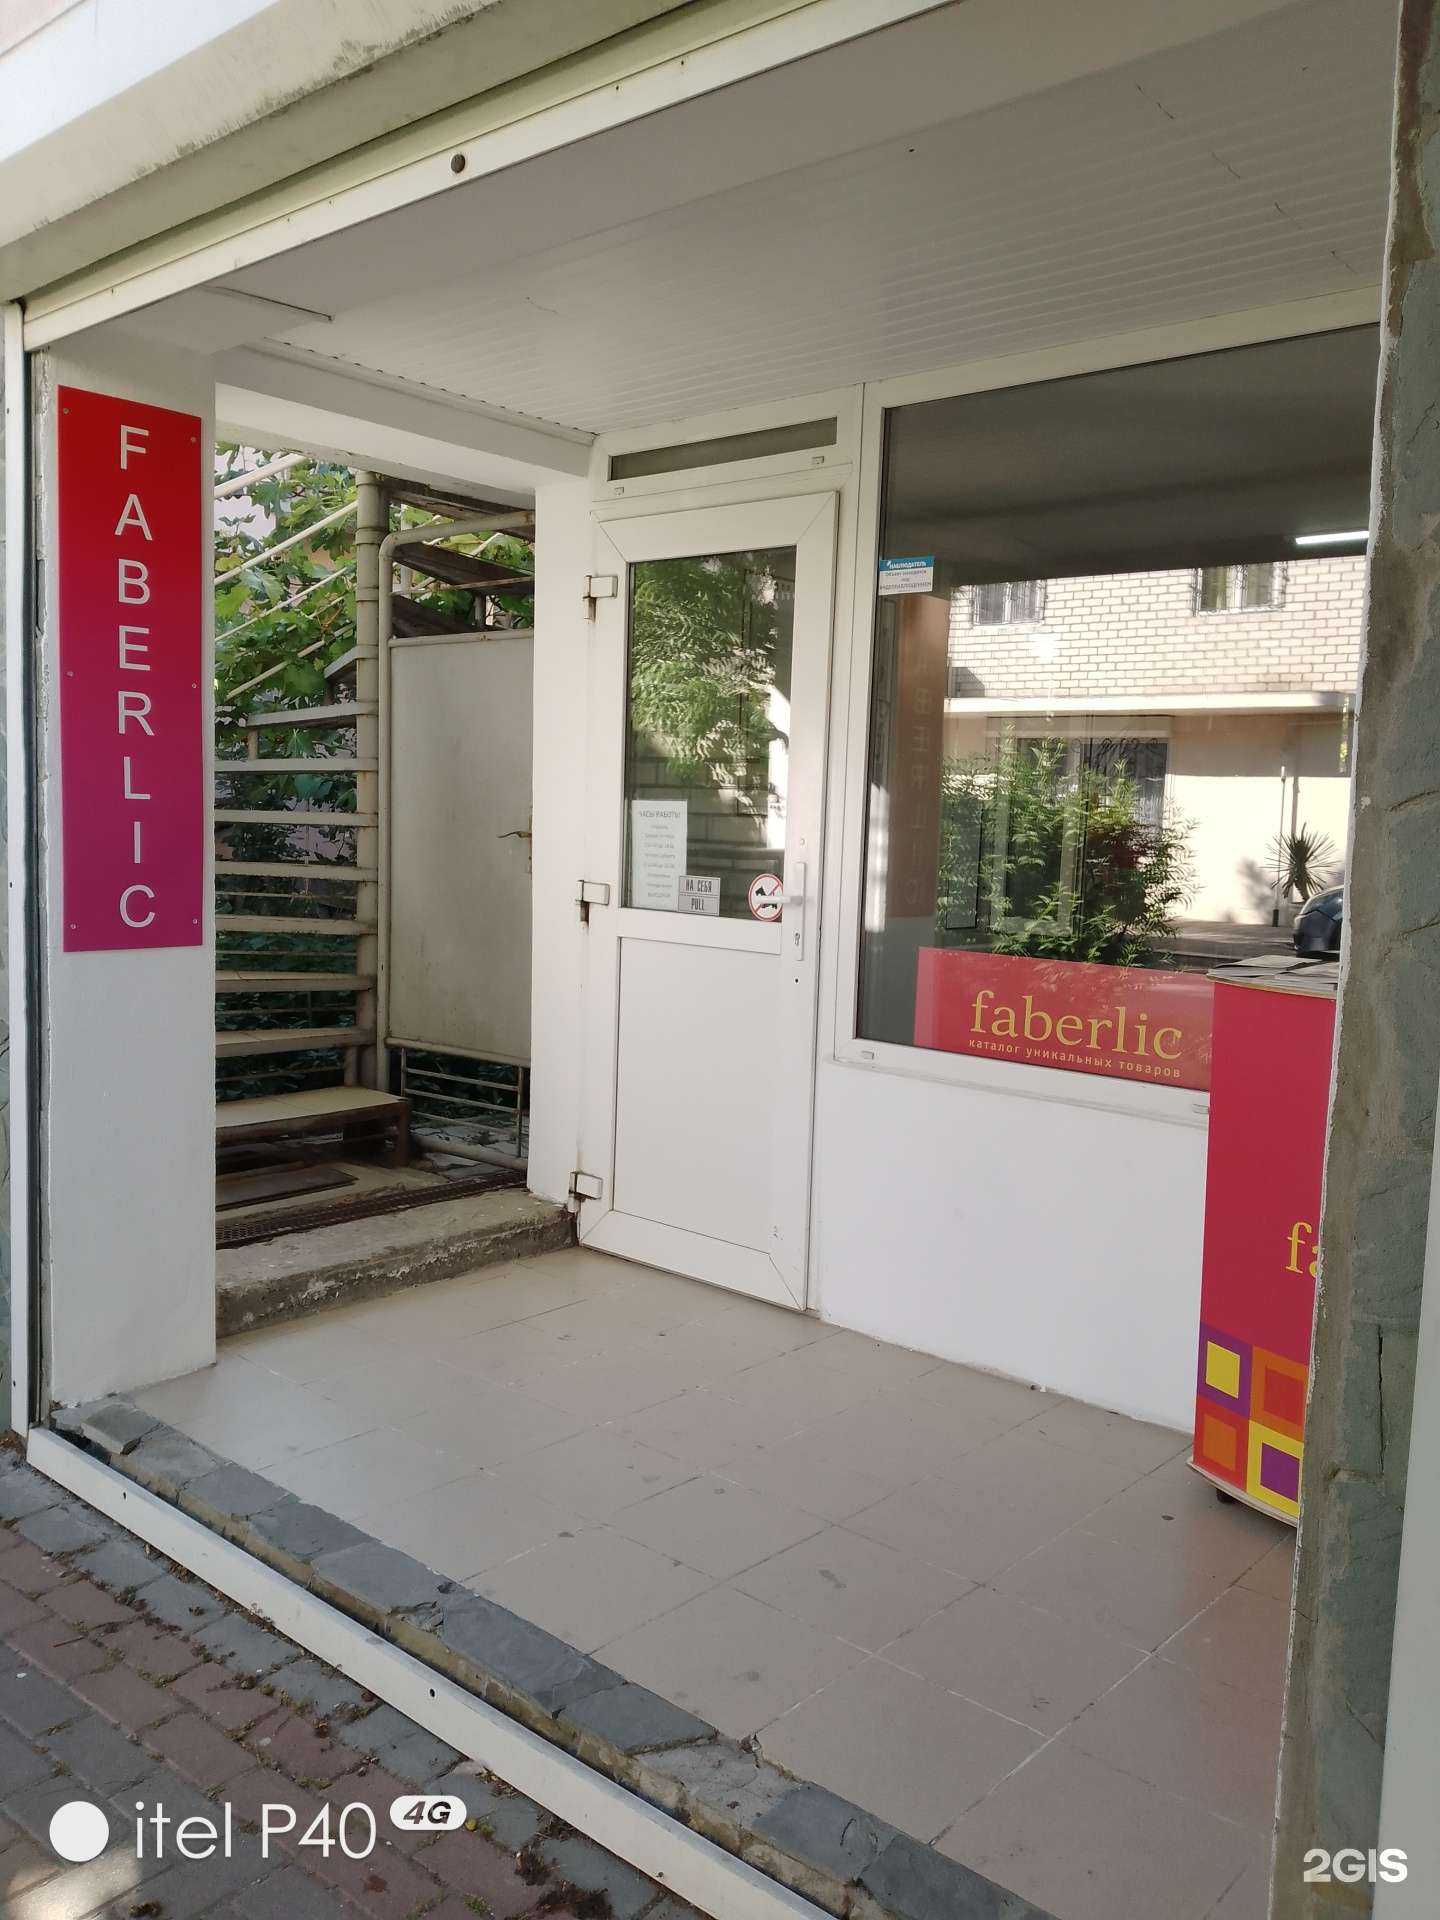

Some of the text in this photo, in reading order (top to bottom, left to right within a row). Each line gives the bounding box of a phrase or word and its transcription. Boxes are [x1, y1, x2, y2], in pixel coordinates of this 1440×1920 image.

[114, 424, 156, 928] FABERLIC
[685, 879, 712, 893] НА СЕБЯ
[690, 897, 705, 911] PULL
[969, 990, 1183, 1060] faberlic
[968, 1038, 1182, 1079] каталог уникальных товаров
